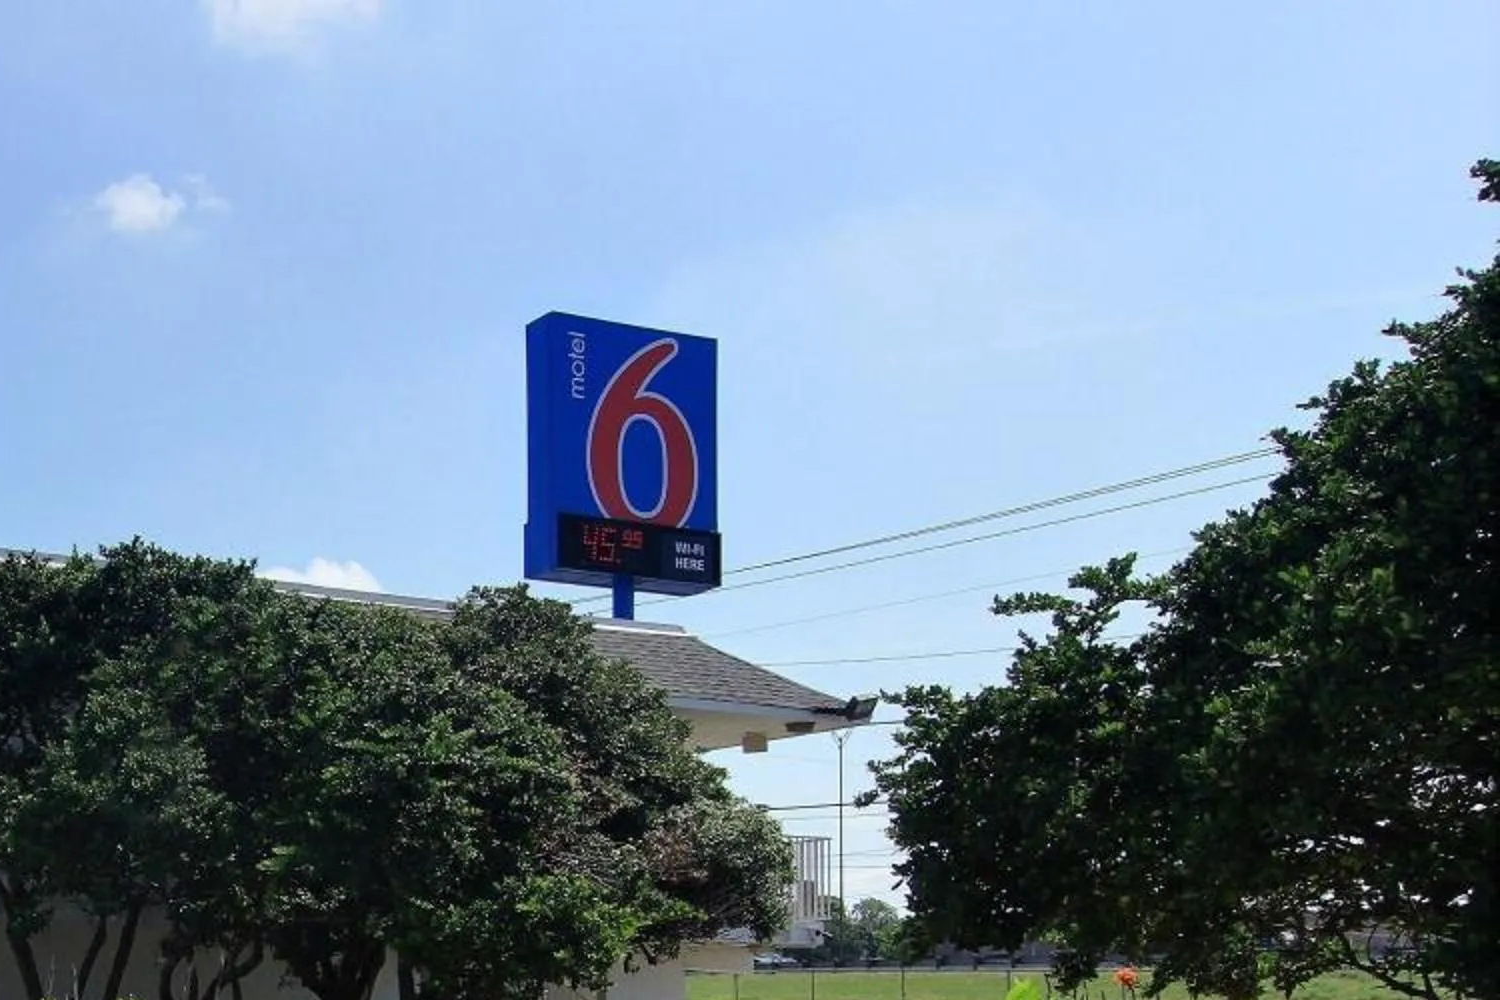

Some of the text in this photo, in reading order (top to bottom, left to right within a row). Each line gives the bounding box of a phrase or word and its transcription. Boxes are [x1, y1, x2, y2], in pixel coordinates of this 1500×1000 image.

[567, 331, 699, 528] motel 6
[675, 557, 705, 571] HERE
